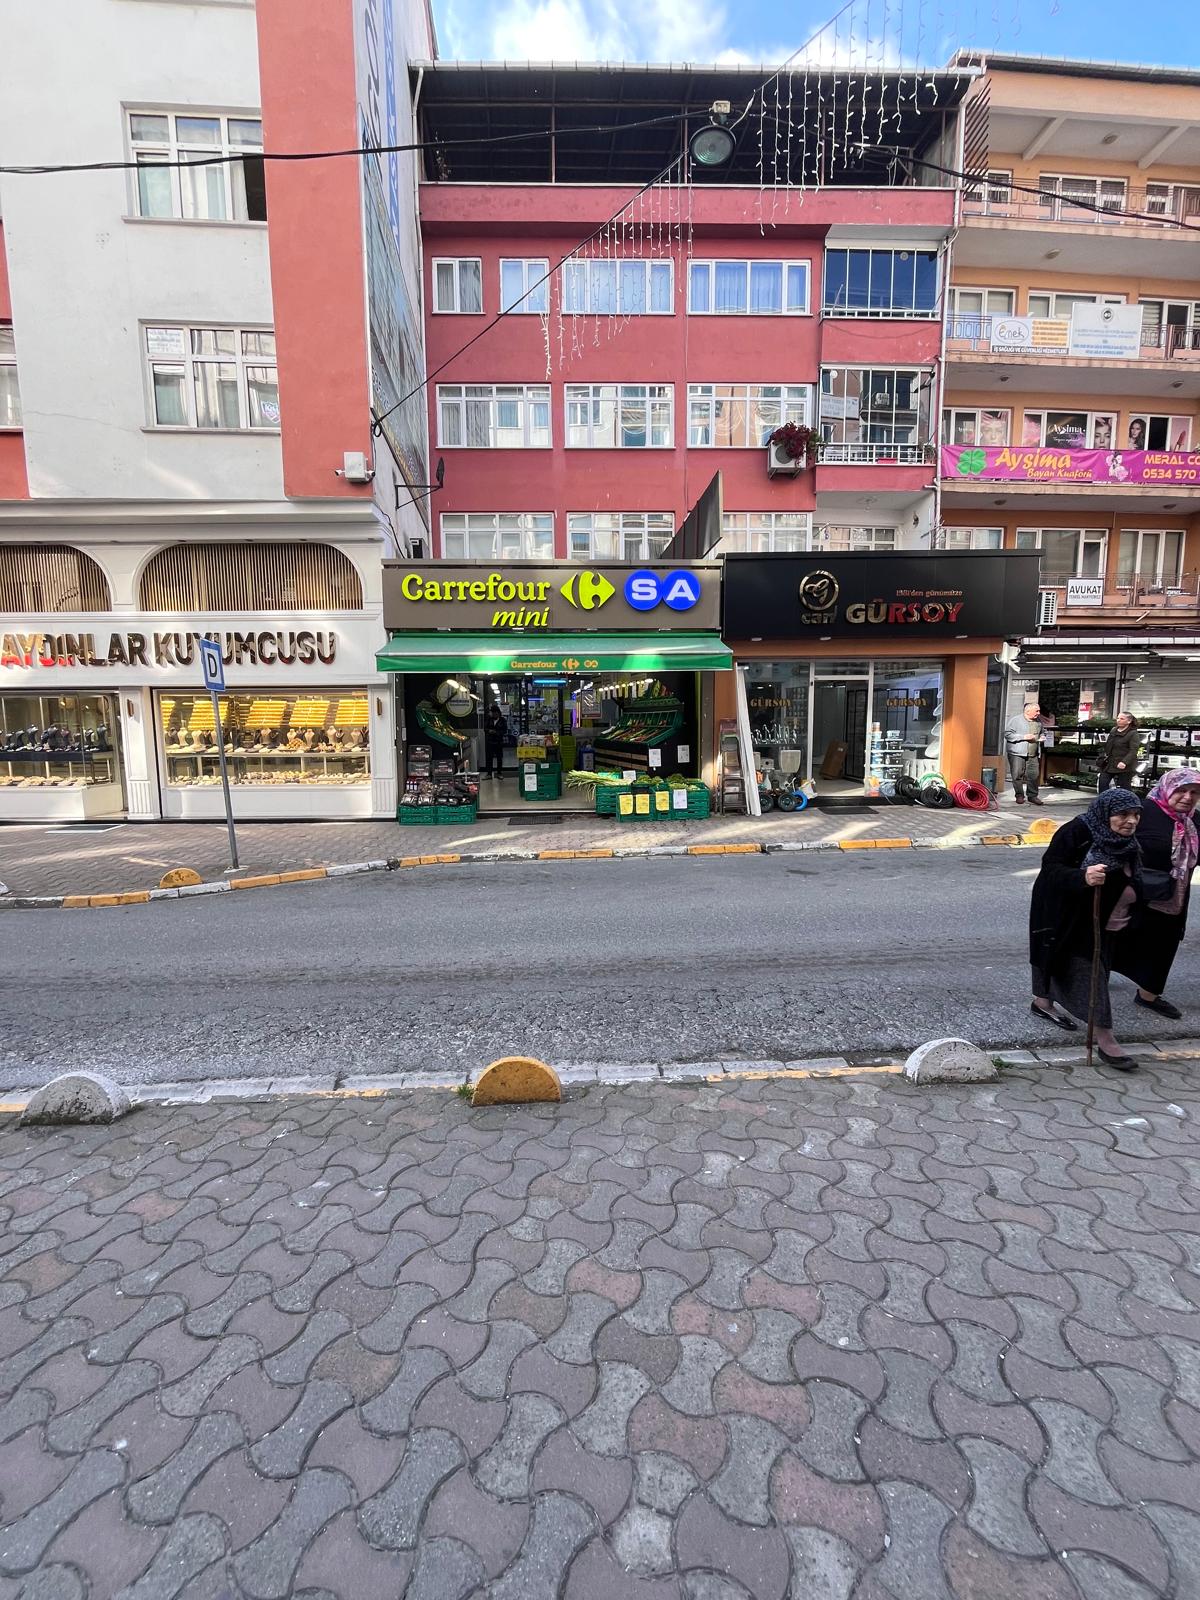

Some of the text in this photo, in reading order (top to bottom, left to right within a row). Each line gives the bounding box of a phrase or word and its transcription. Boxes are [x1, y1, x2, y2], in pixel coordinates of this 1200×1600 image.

[995, 447, 1072, 472] Aysima
[1144, 454, 1185, 465] MERAL
[1027, 468, 1093, 480] Bayan Kuaförü
[1142, 468, 1197, 480] 0534 570
[401, 573, 552, 602] Carrefour
[1069, 585, 1102, 595] AVUKAT
[491, 606, 549, 628] mini
[846, 599, 965, 624] GÜRSOY
[0, 632, 152, 667] AYDINLAR
[207, 652, 218, 678] D
[511, 660, 557, 669] Carrefour
